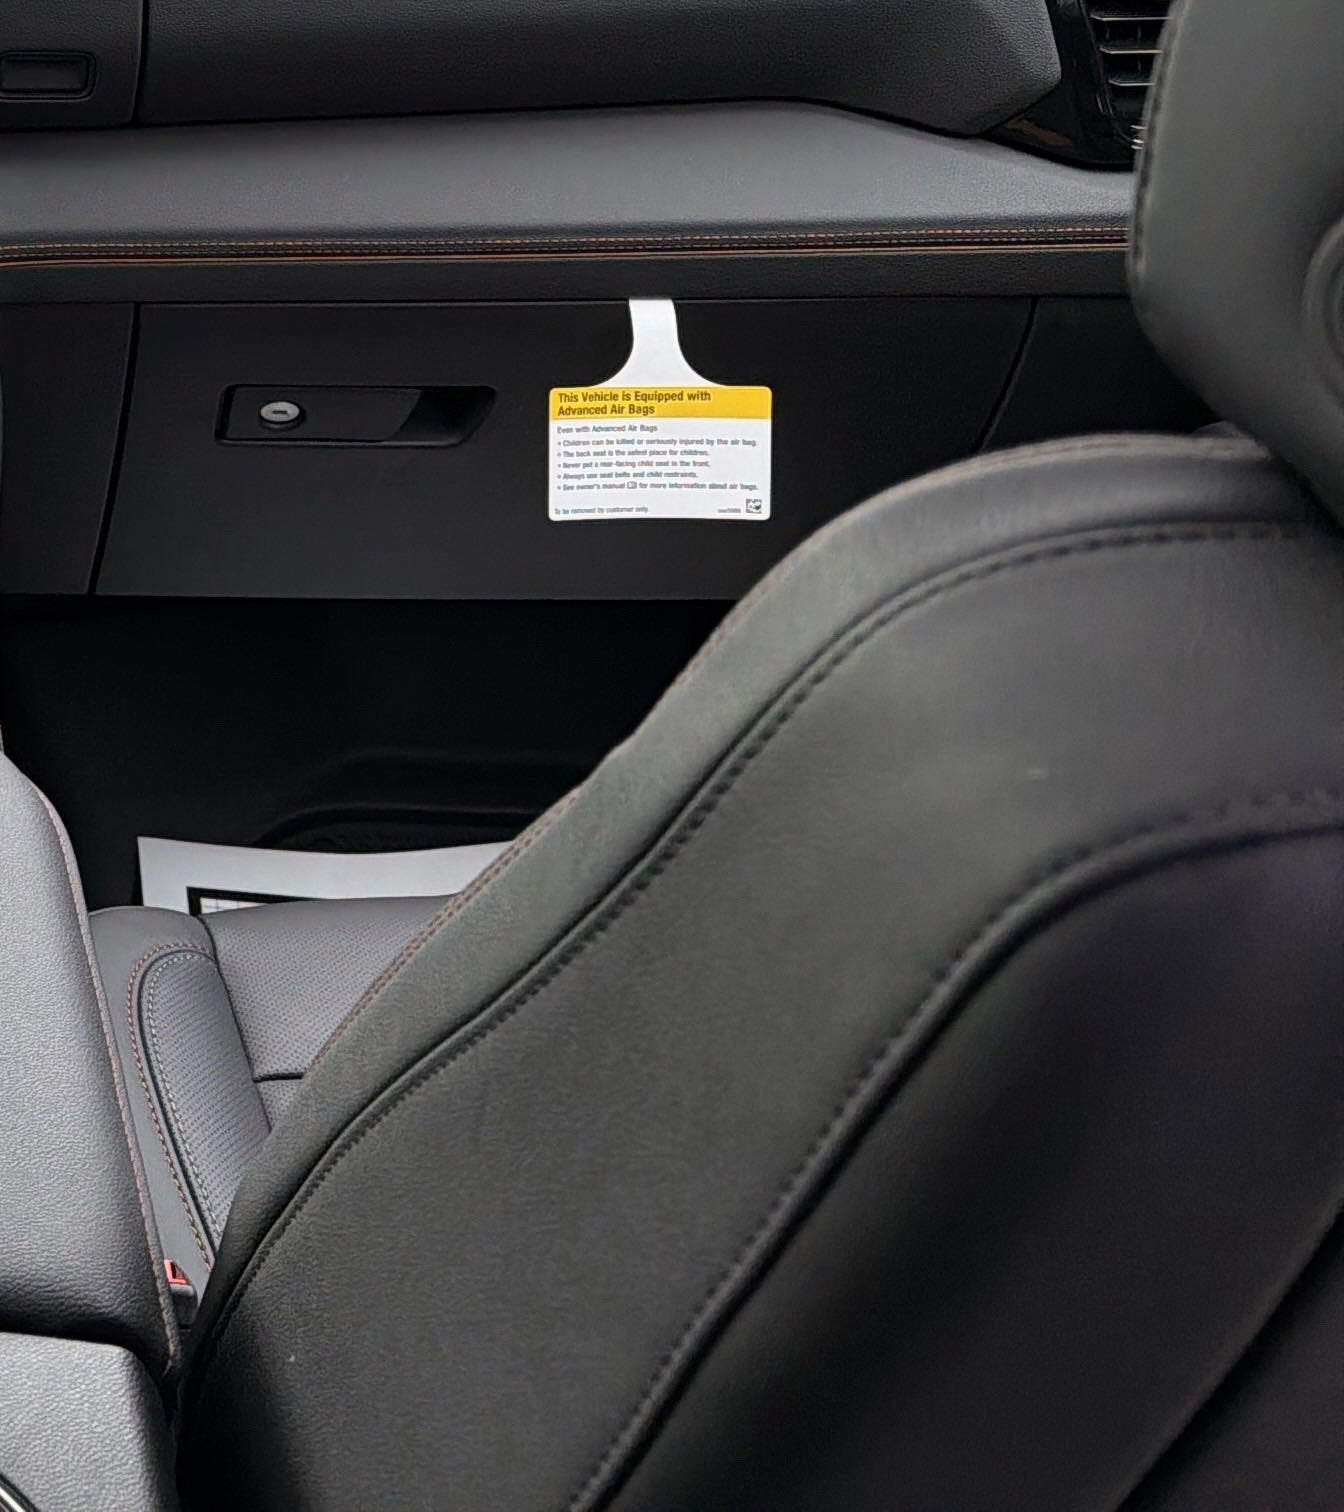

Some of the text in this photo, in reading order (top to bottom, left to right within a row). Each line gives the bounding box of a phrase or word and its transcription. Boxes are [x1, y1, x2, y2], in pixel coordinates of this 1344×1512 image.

[558, 391, 711, 403] This Vehicle is Equipped with
[558, 404, 655, 416] Advanced Air Bags
[640, 424, 658, 433] Bags
